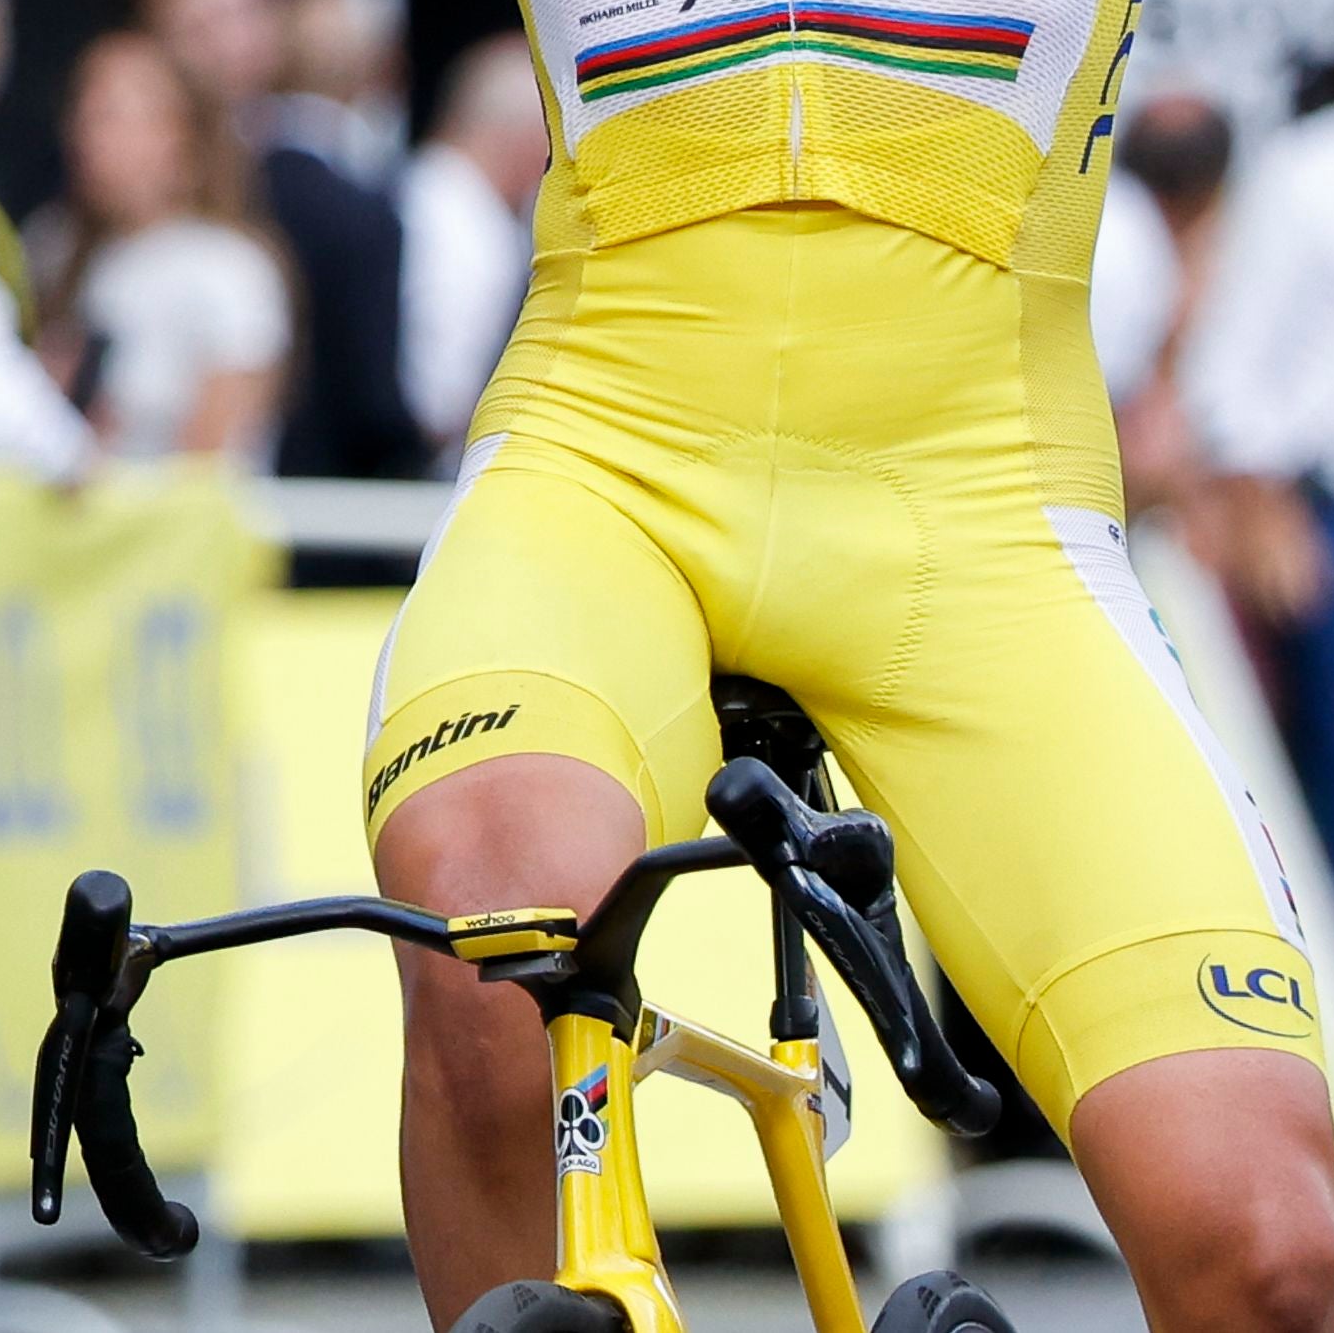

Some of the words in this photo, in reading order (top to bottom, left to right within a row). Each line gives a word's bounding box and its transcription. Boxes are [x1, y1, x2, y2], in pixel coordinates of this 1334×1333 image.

[368, 704, 521, 827] Santini
[464, 913, 516, 928] wahoo
[1209, 964, 1315, 1020] LCL
